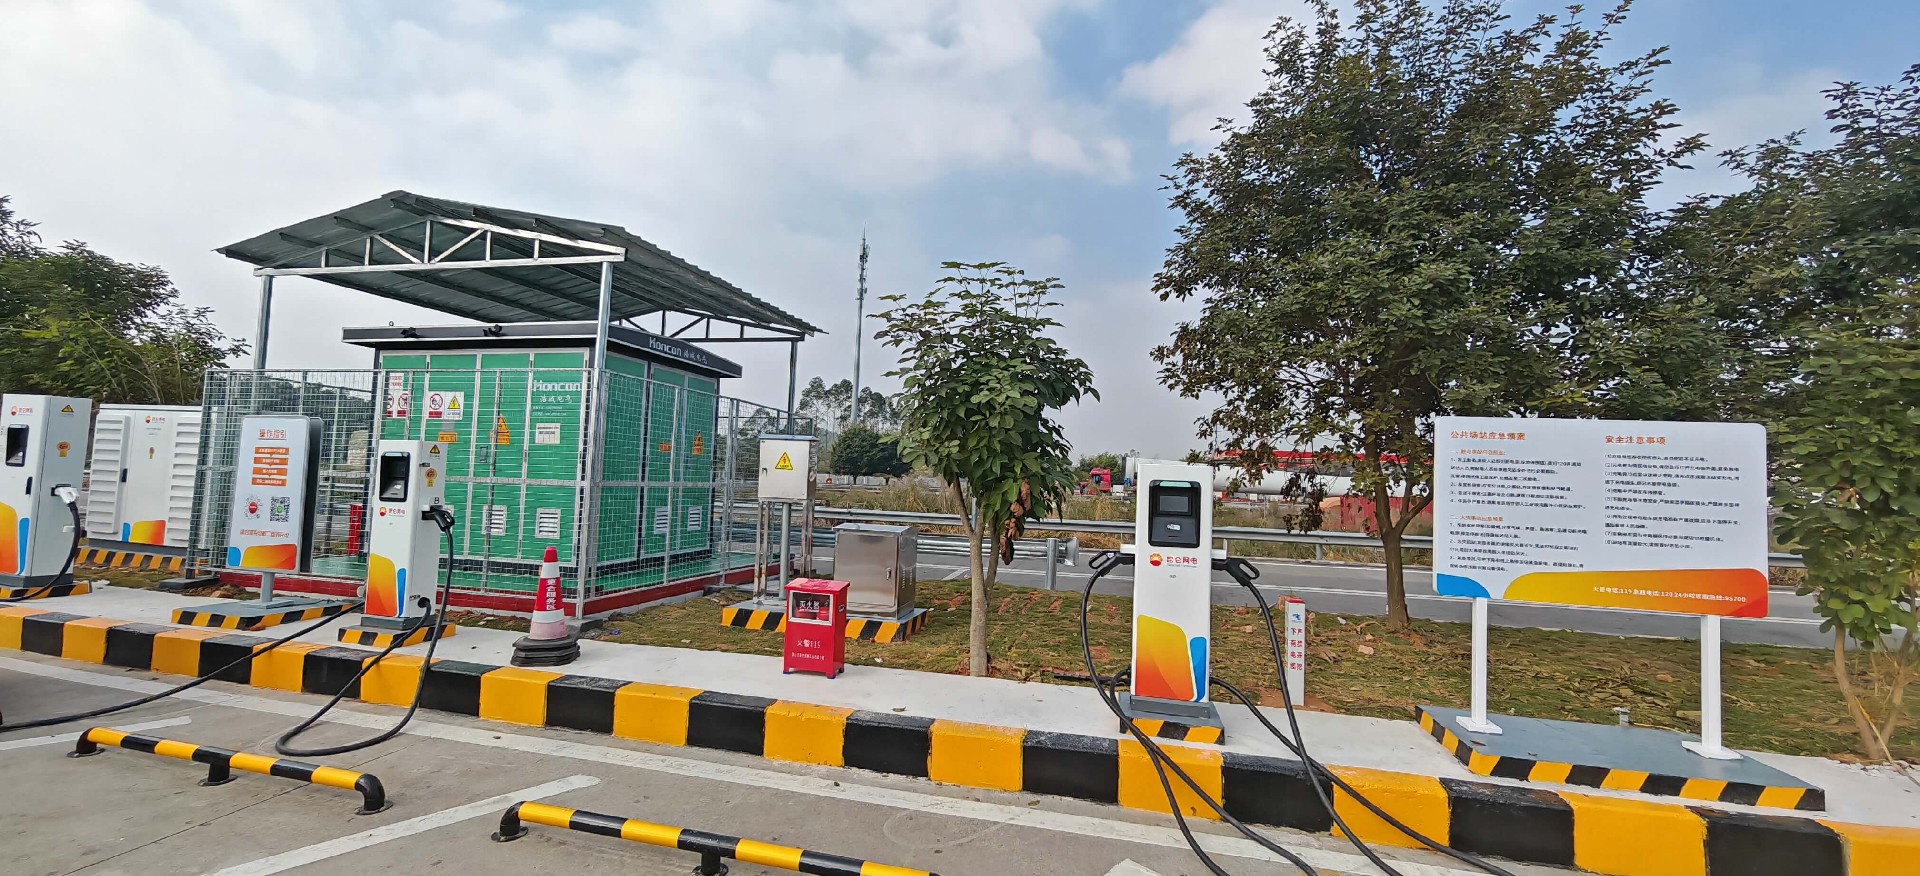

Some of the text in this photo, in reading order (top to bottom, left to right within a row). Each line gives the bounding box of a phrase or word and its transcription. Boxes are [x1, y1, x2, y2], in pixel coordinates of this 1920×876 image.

[1450, 431, 1526, 441] 公共场站应急预案
[1605, 435, 1666, 445] 安全注意事项
